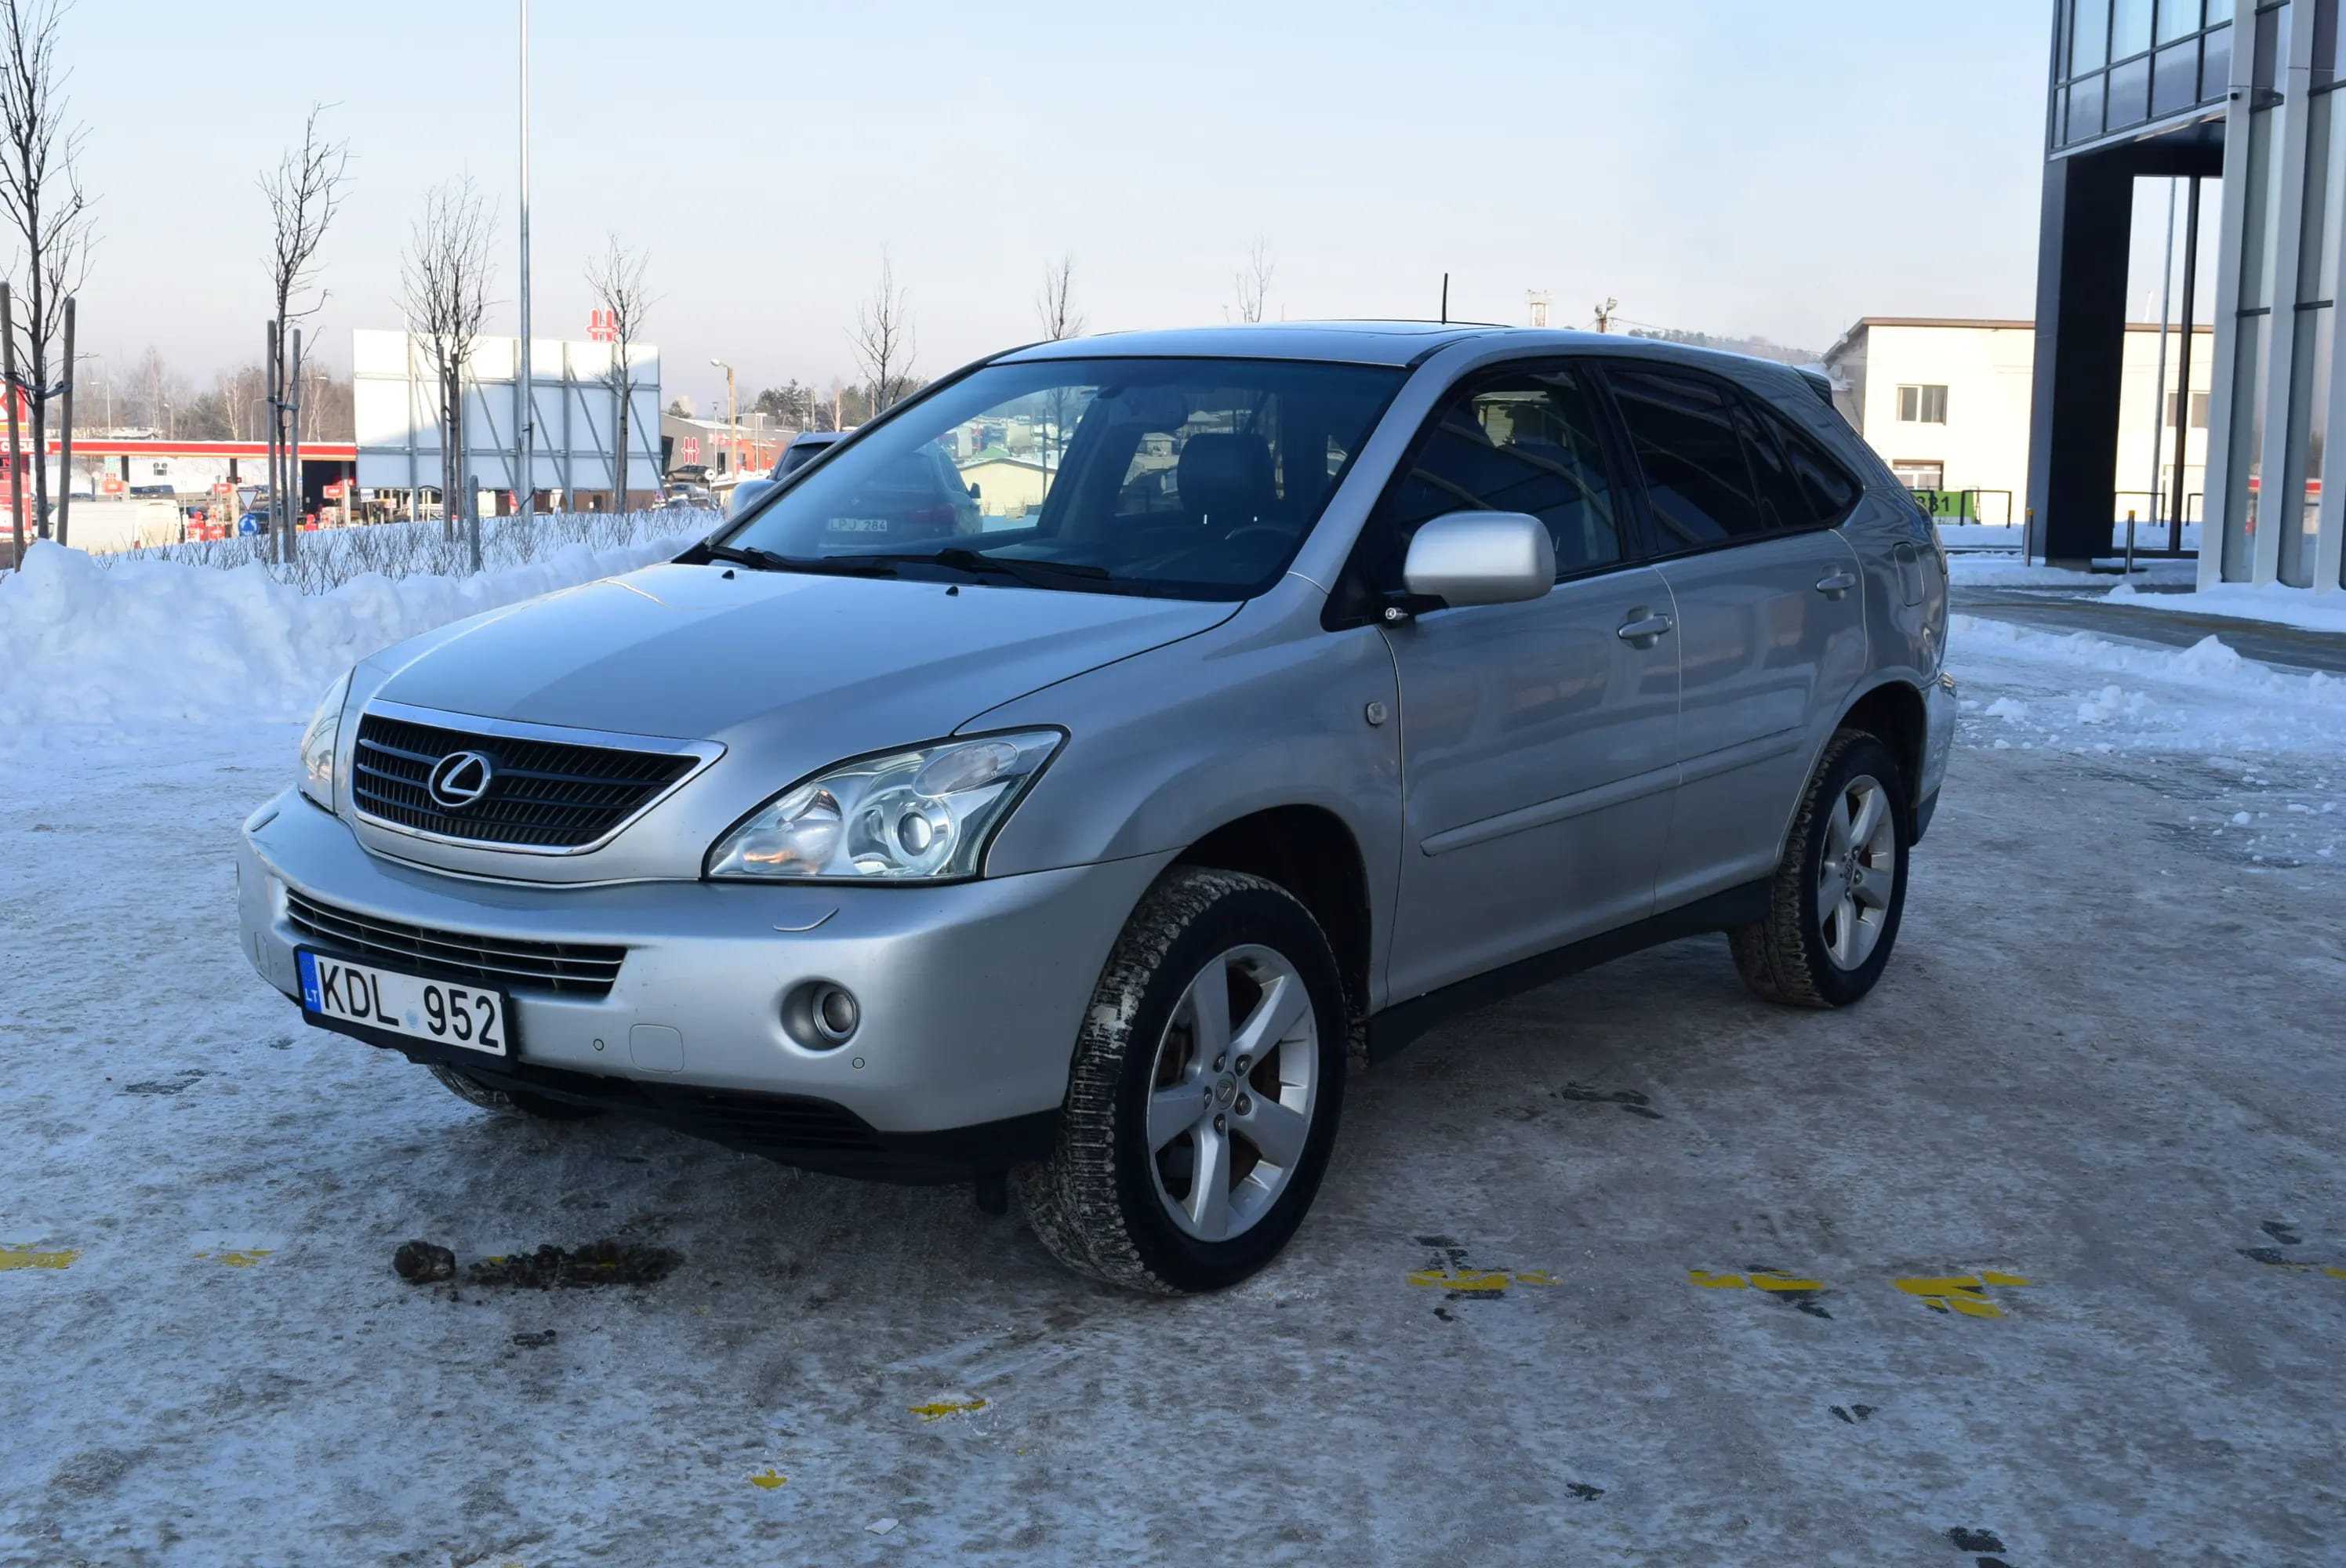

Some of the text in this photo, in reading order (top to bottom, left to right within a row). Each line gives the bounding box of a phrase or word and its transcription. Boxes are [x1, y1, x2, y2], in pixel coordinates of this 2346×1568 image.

[1, 441, 35, 452] CCLE
[831, 520, 885, 530] LPJ 284
[304, 988, 318, 1003] LT
[319, 961, 499, 1048] KDL 952
